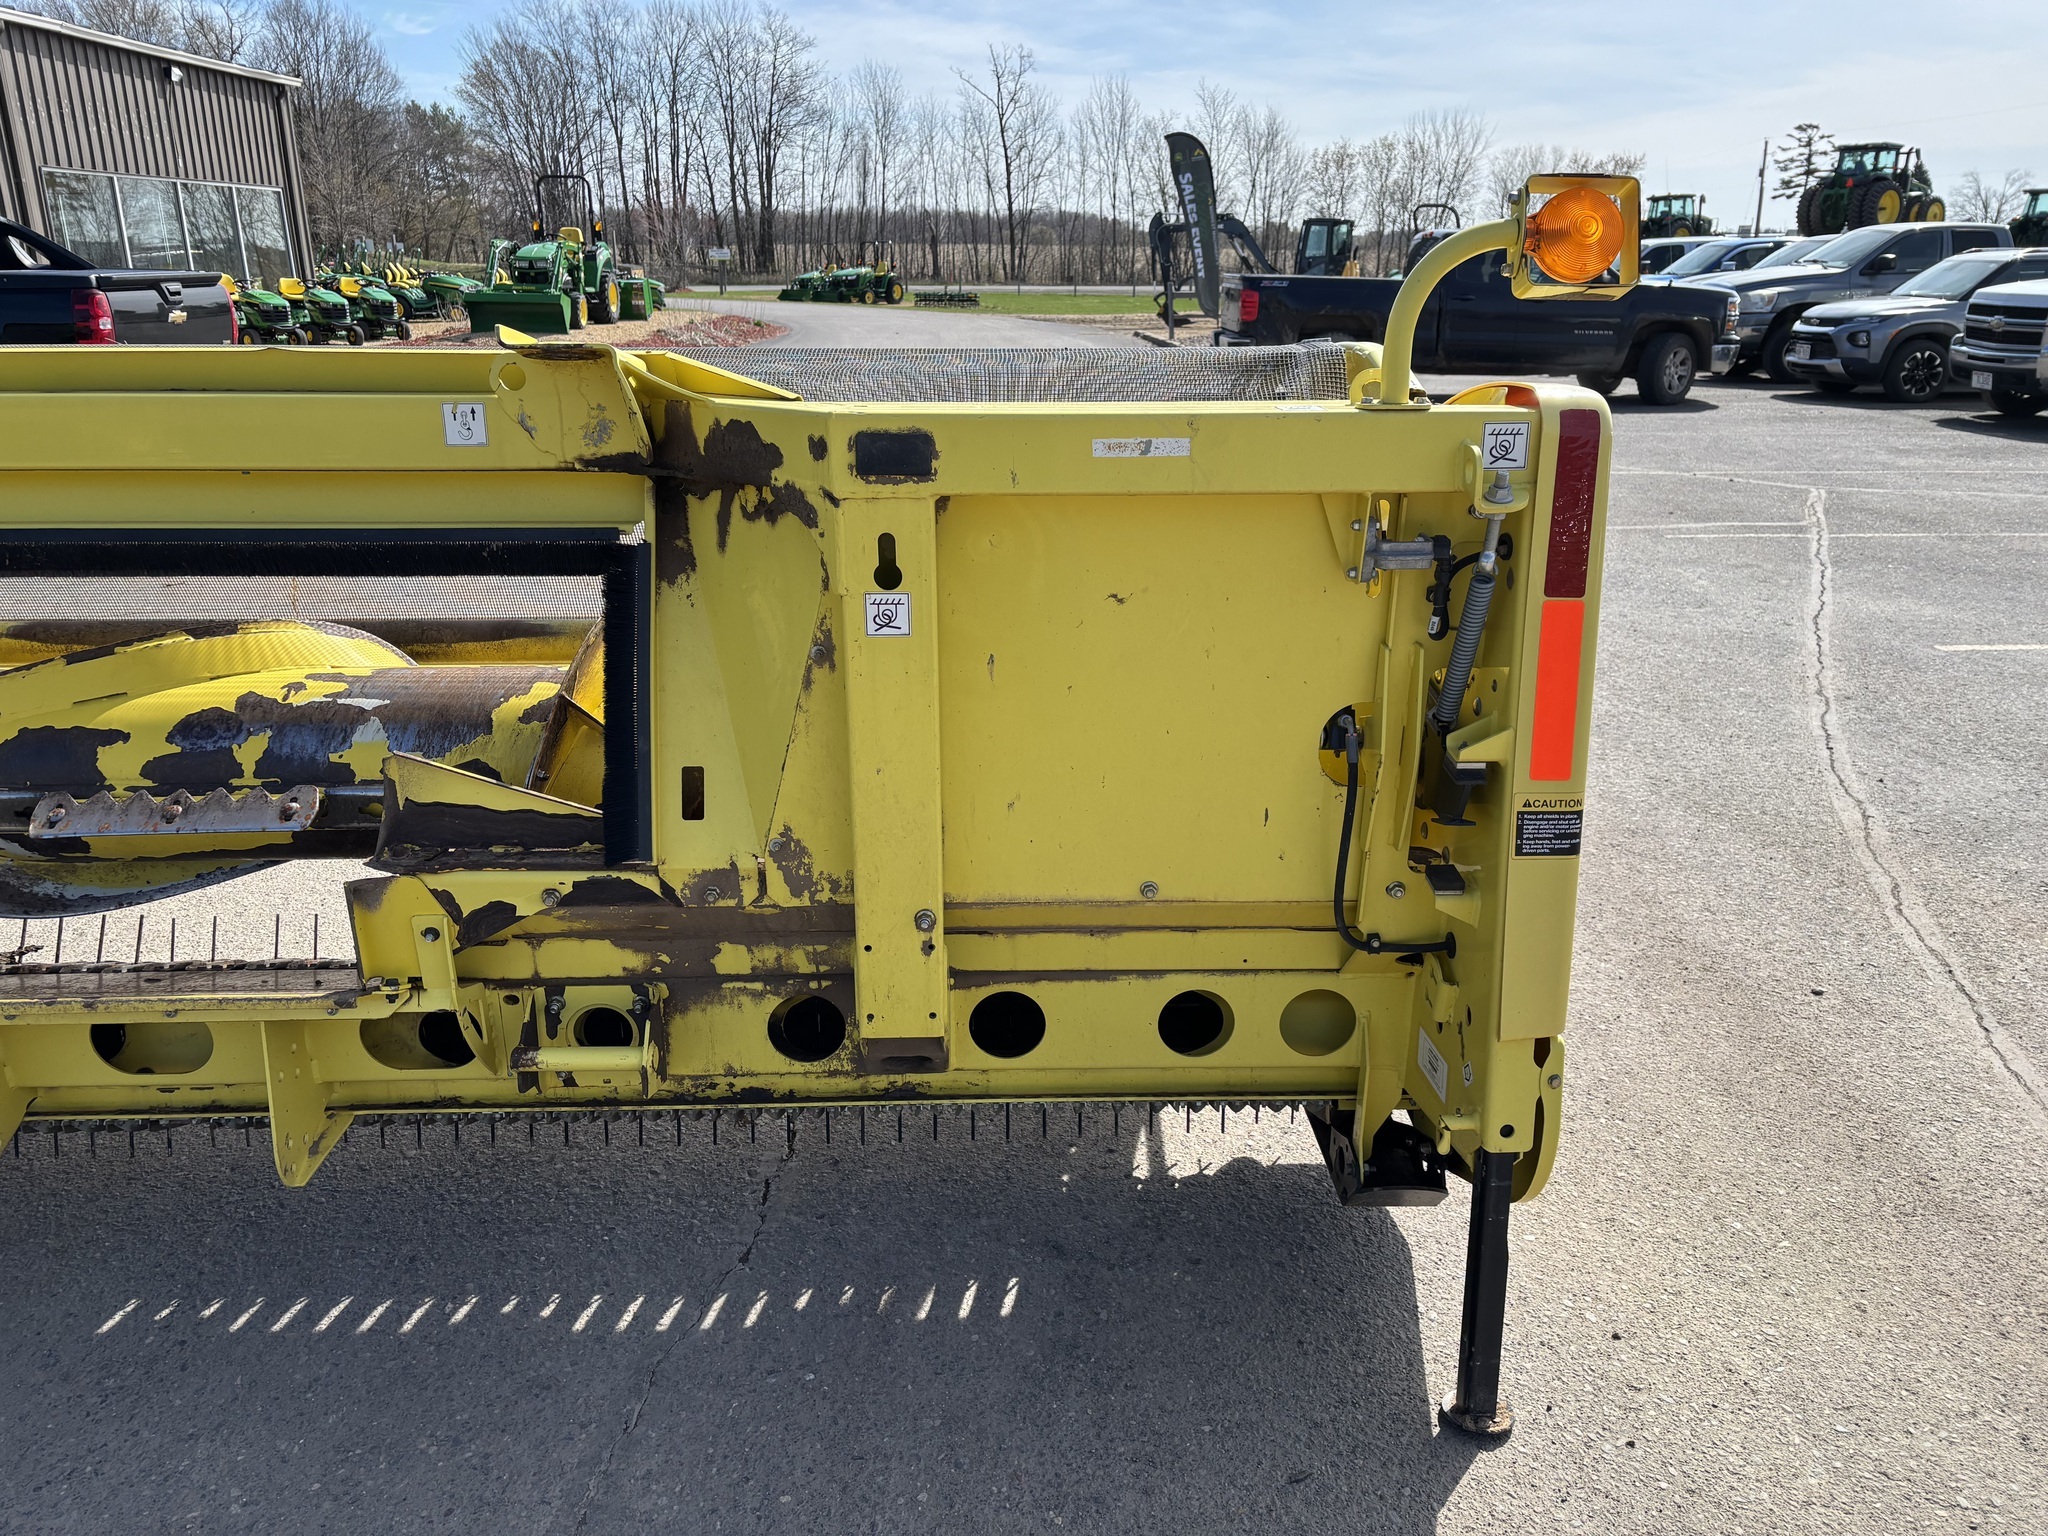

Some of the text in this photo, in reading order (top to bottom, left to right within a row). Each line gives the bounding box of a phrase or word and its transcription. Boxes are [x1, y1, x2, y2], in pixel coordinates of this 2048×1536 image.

[1178, 172, 1198, 223] SALES
[1191, 226, 1205, 279] EVENT
[1532, 799, 1582, 808] CAUTION
